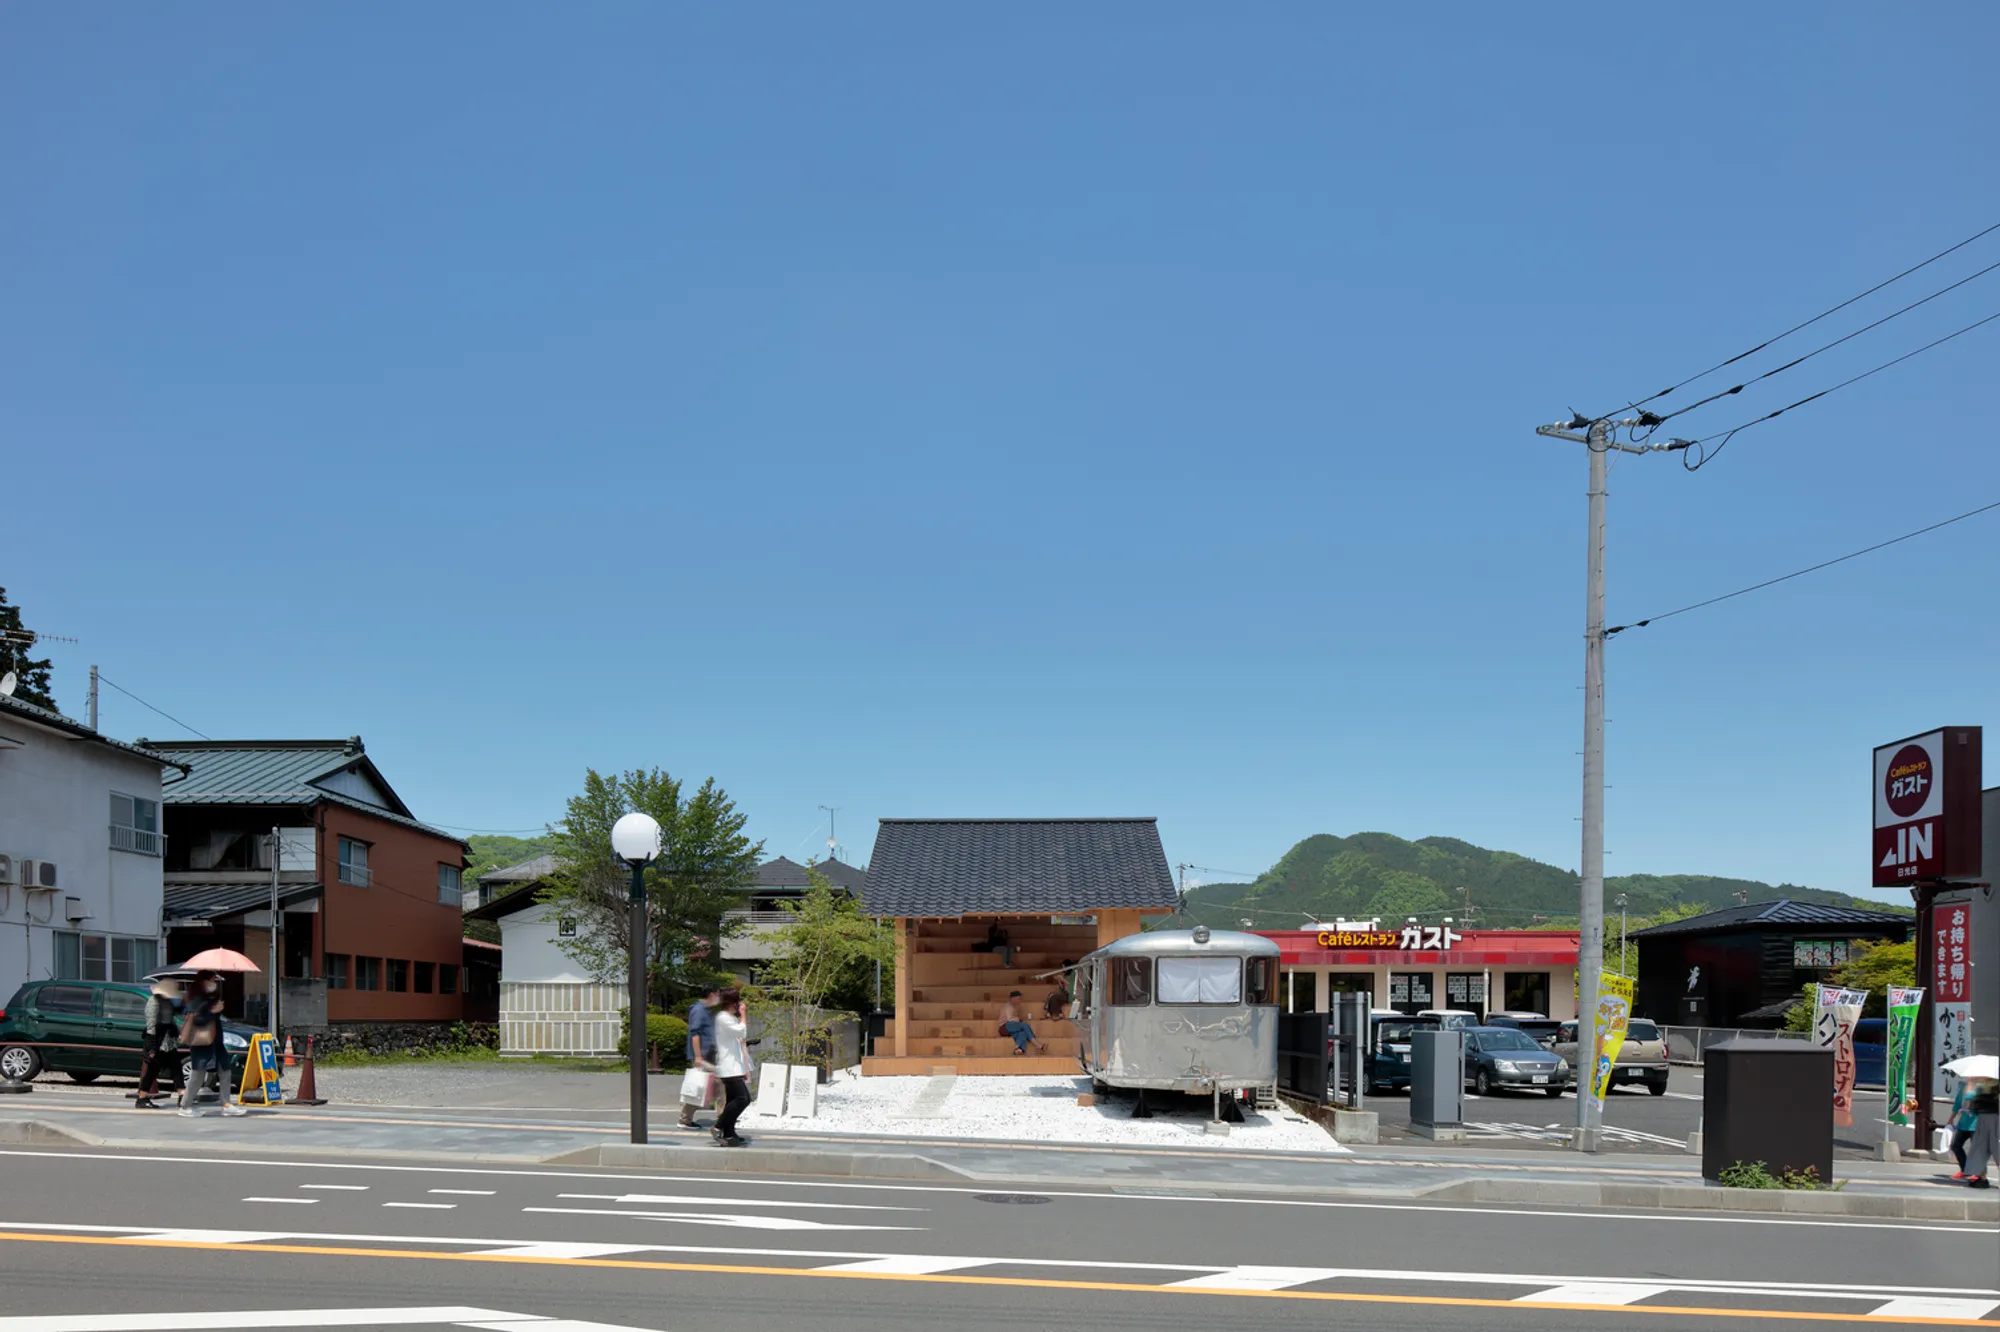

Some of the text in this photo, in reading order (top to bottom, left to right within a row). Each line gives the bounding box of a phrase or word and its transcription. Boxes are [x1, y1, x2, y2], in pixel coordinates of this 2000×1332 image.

[1891, 774, 1928, 799] ガスト
[1897, 822, 1934, 865] IN
[1400, 926, 1462, 950] ガスト
[1950, 909, 1966, 999] お持ち帰り
[1937, 929, 1947, 996] できます
[262, 1044, 272, 1063] P
